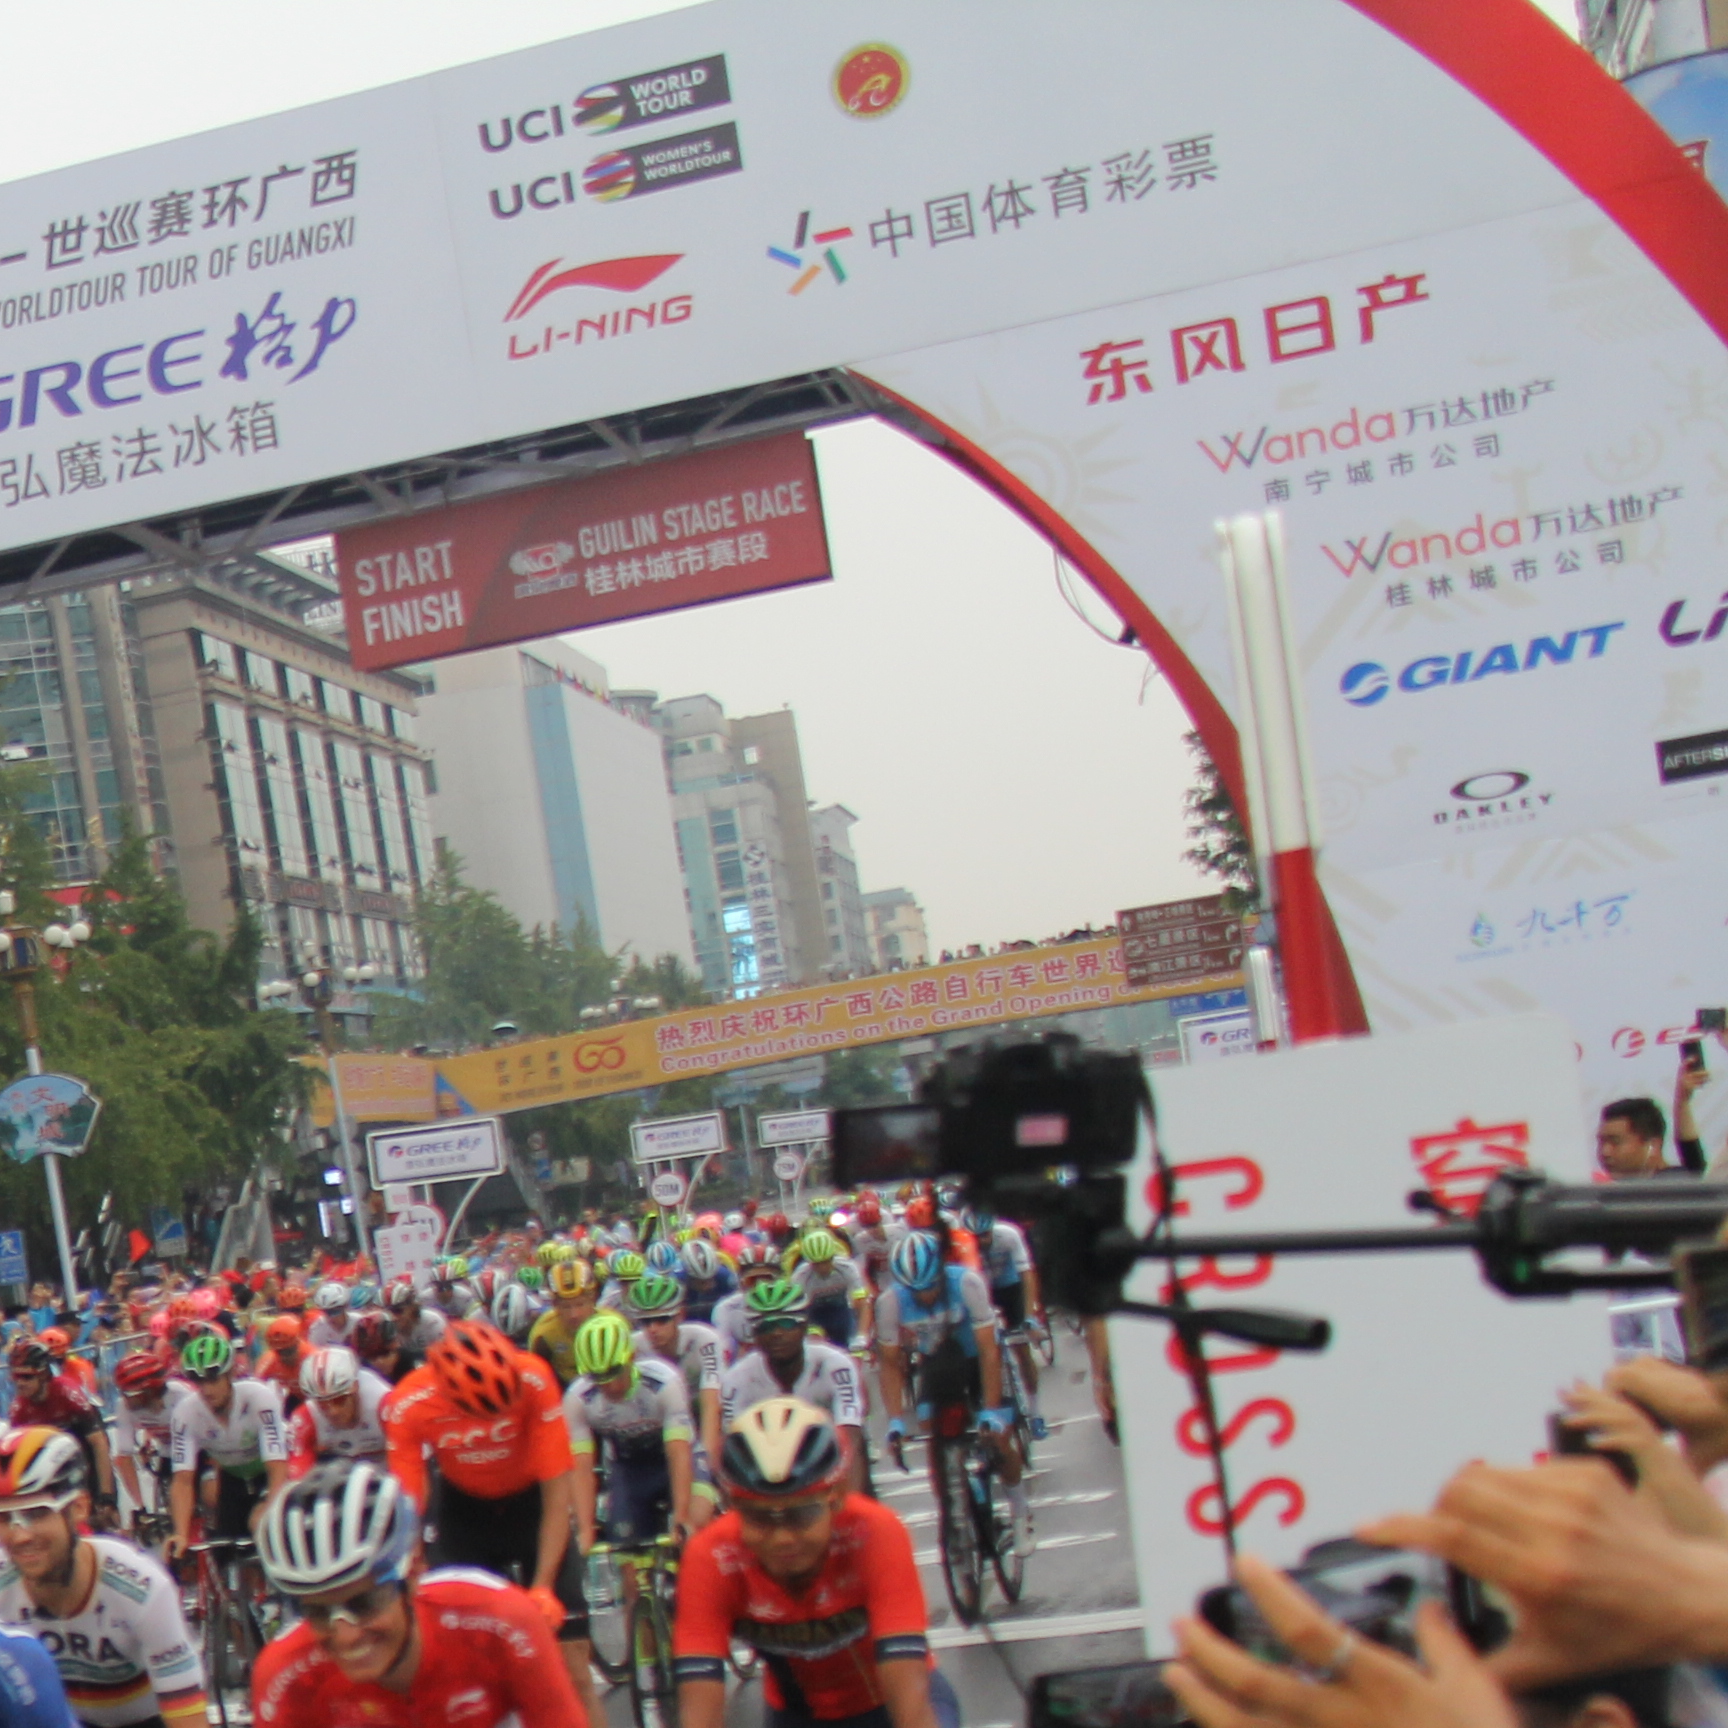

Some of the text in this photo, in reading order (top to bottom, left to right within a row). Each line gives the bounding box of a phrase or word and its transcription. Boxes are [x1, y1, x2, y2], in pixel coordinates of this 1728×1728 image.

[630, 67, 708, 100] WORLD
[636, 89, 694, 118] TOUR
[478, 105, 566, 153] UCI
[641, 141, 714, 169] WOMEN'S
[488, 172, 576, 220] UCI
[644, 150, 732, 182] WORLDTOUR
[869, 134, 1219, 260] 中国体育彩票
[137, 256, 199, 297] TOUR
[208, 243, 238, 279] OF
[246, 216, 355, 269] GUANGXI
[507, 295, 693, 361] LI-NING
[1080, 273, 1430, 405] 东风日产
[1196, 378, 1555, 474] Wanda 万达地产
[1263, 433, 1501, 504] 南宁城市公司
[577, 480, 806, 558] GUILIN STAGE RACE
[1319, 484, 1684, 578] Wanda 万达地产
[355, 542, 454, 597] START
[584, 532, 770, 597] 桂林城市赛段
[1384, 540, 1624, 609] 桂林城市公司
[361, 591, 464, 646] FINISH
[1396, 621, 1626, 692] GIANT
[1432, 792, 1554, 826] OAKLEY
[659, 982, 1112, 1074] Congratulations on the Grand Opening
[1221, 1028, 1251, 1044] GR
[830, 1366, 858, 1417] BMC
